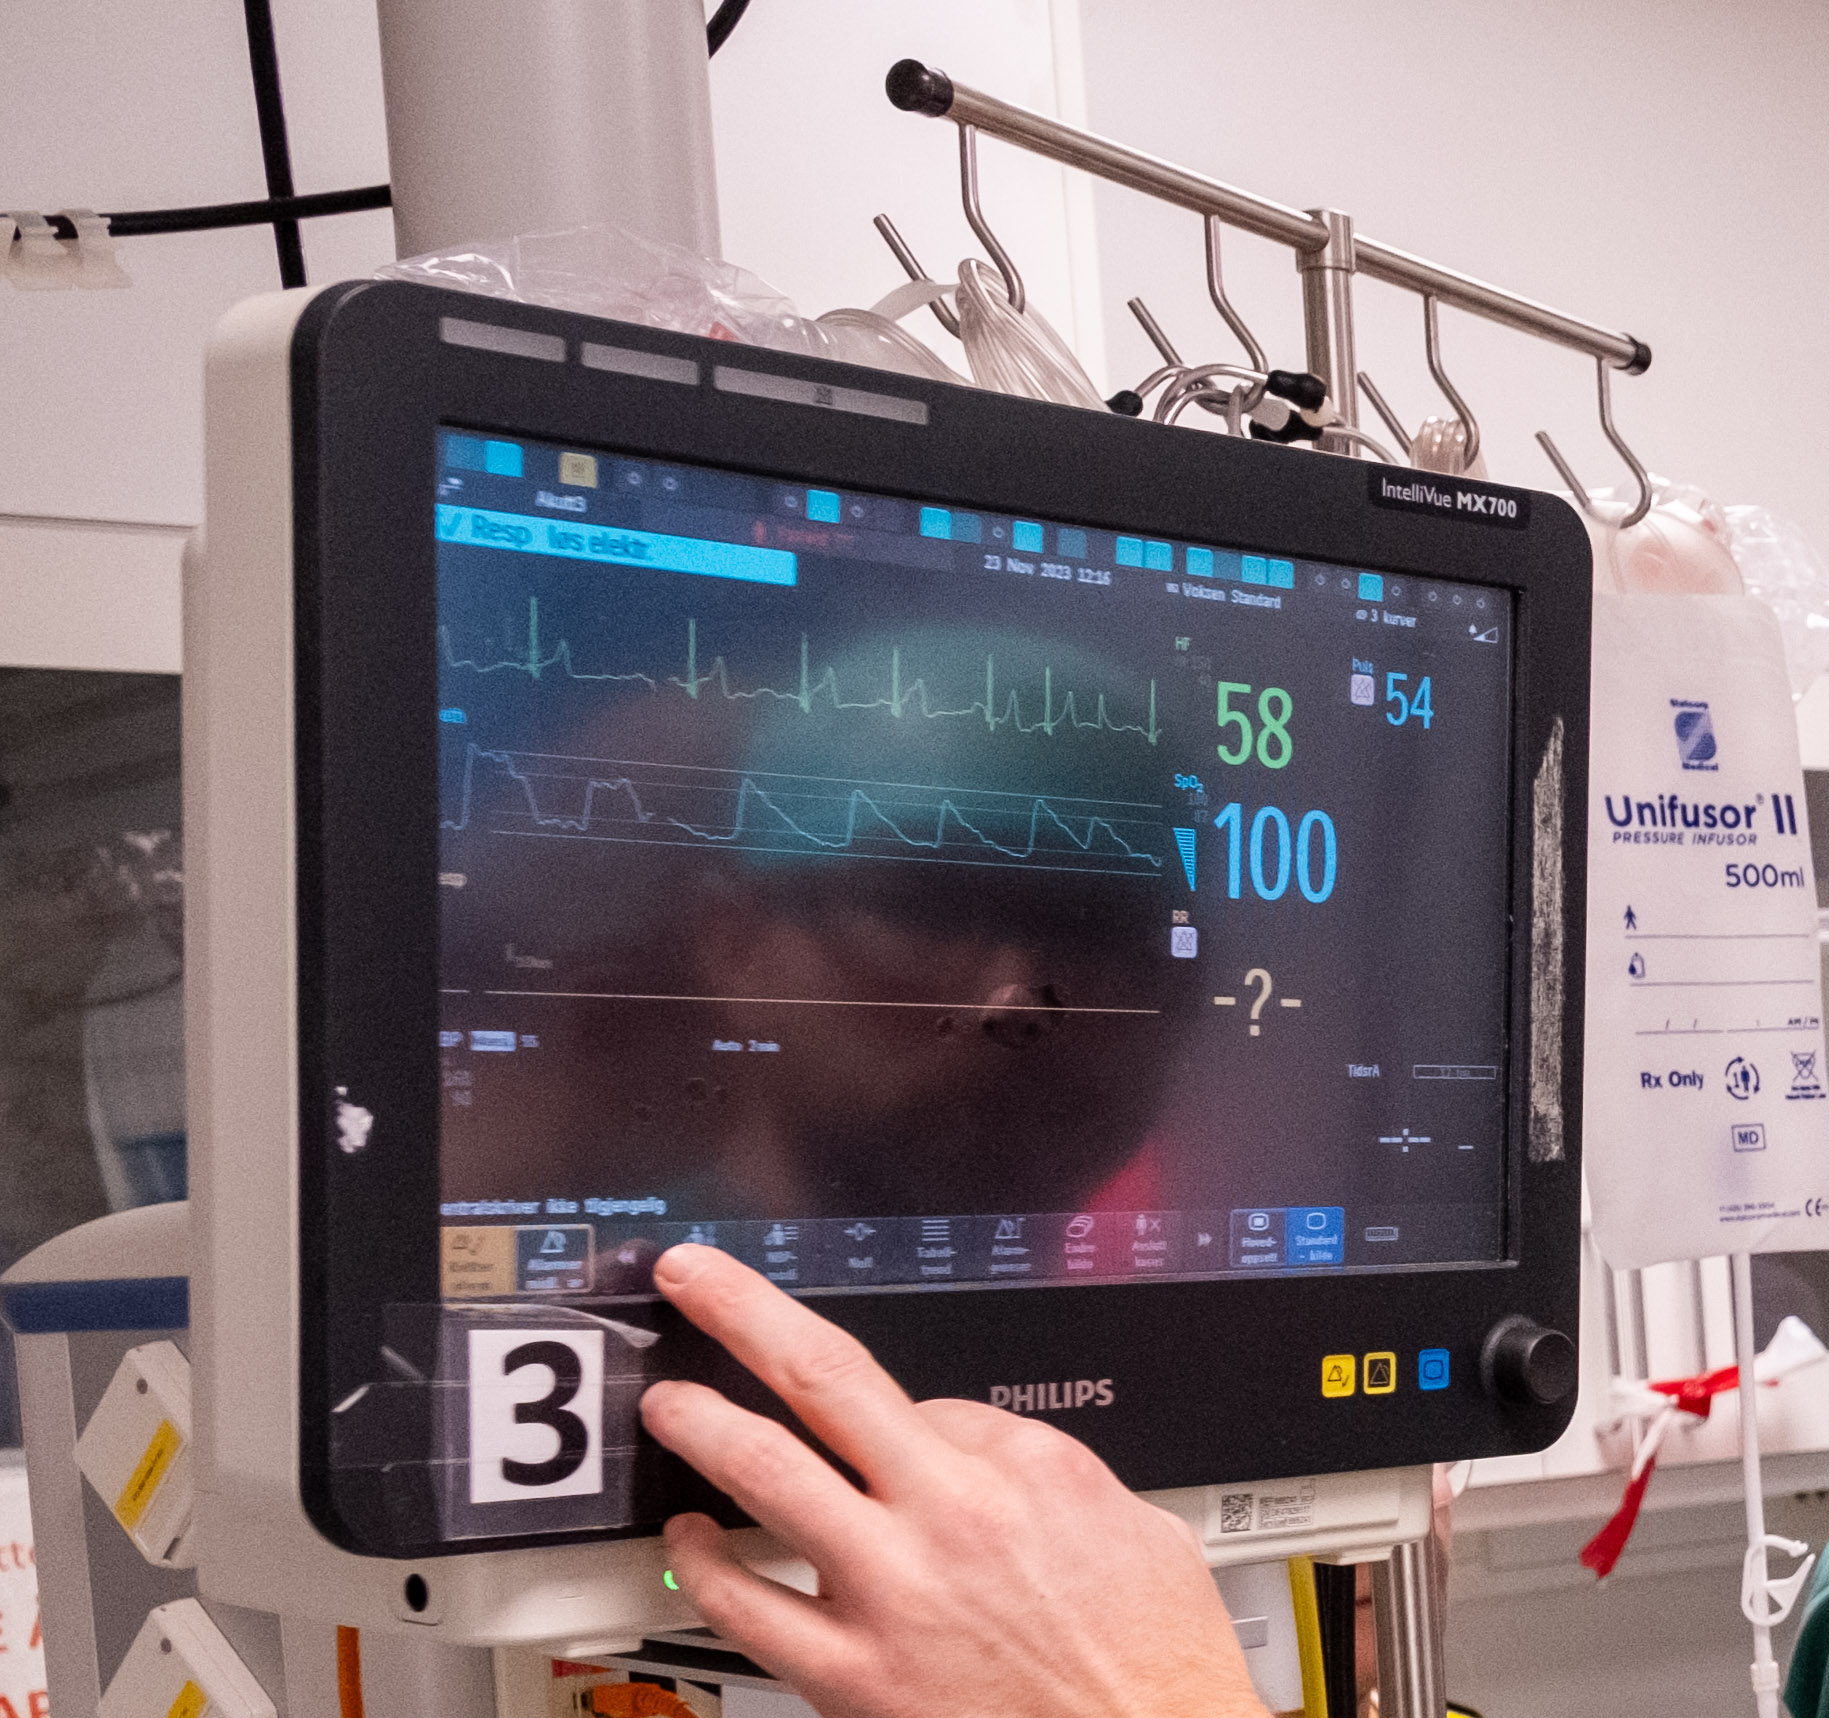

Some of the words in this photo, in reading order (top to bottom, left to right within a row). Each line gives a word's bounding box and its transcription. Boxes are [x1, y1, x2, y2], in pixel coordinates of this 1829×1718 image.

[1381, 477, 1452, 508] IntelliVue
[1456, 490, 1517, 519] MX700
[1041, 561, 1072, 580] 2023
[1386, 672, 1435, 729] 54
[1216, 681, 1294, 769] 58
[1213, 803, 1338, 904] 100
[1612, 831, 1684, 845] PRESSURE
[1692, 833, 1757, 846] INFUSOR
[1725, 863, 1805, 889] 500ml
[1640, 1071, 1661, 1089] Rx
[1668, 1071, 1704, 1091] Only
[1738, 1130, 1759, 1146] MD
[989, 1378, 1115, 1412] PHILIPS
[501, 1340, 590, 1486] 3
